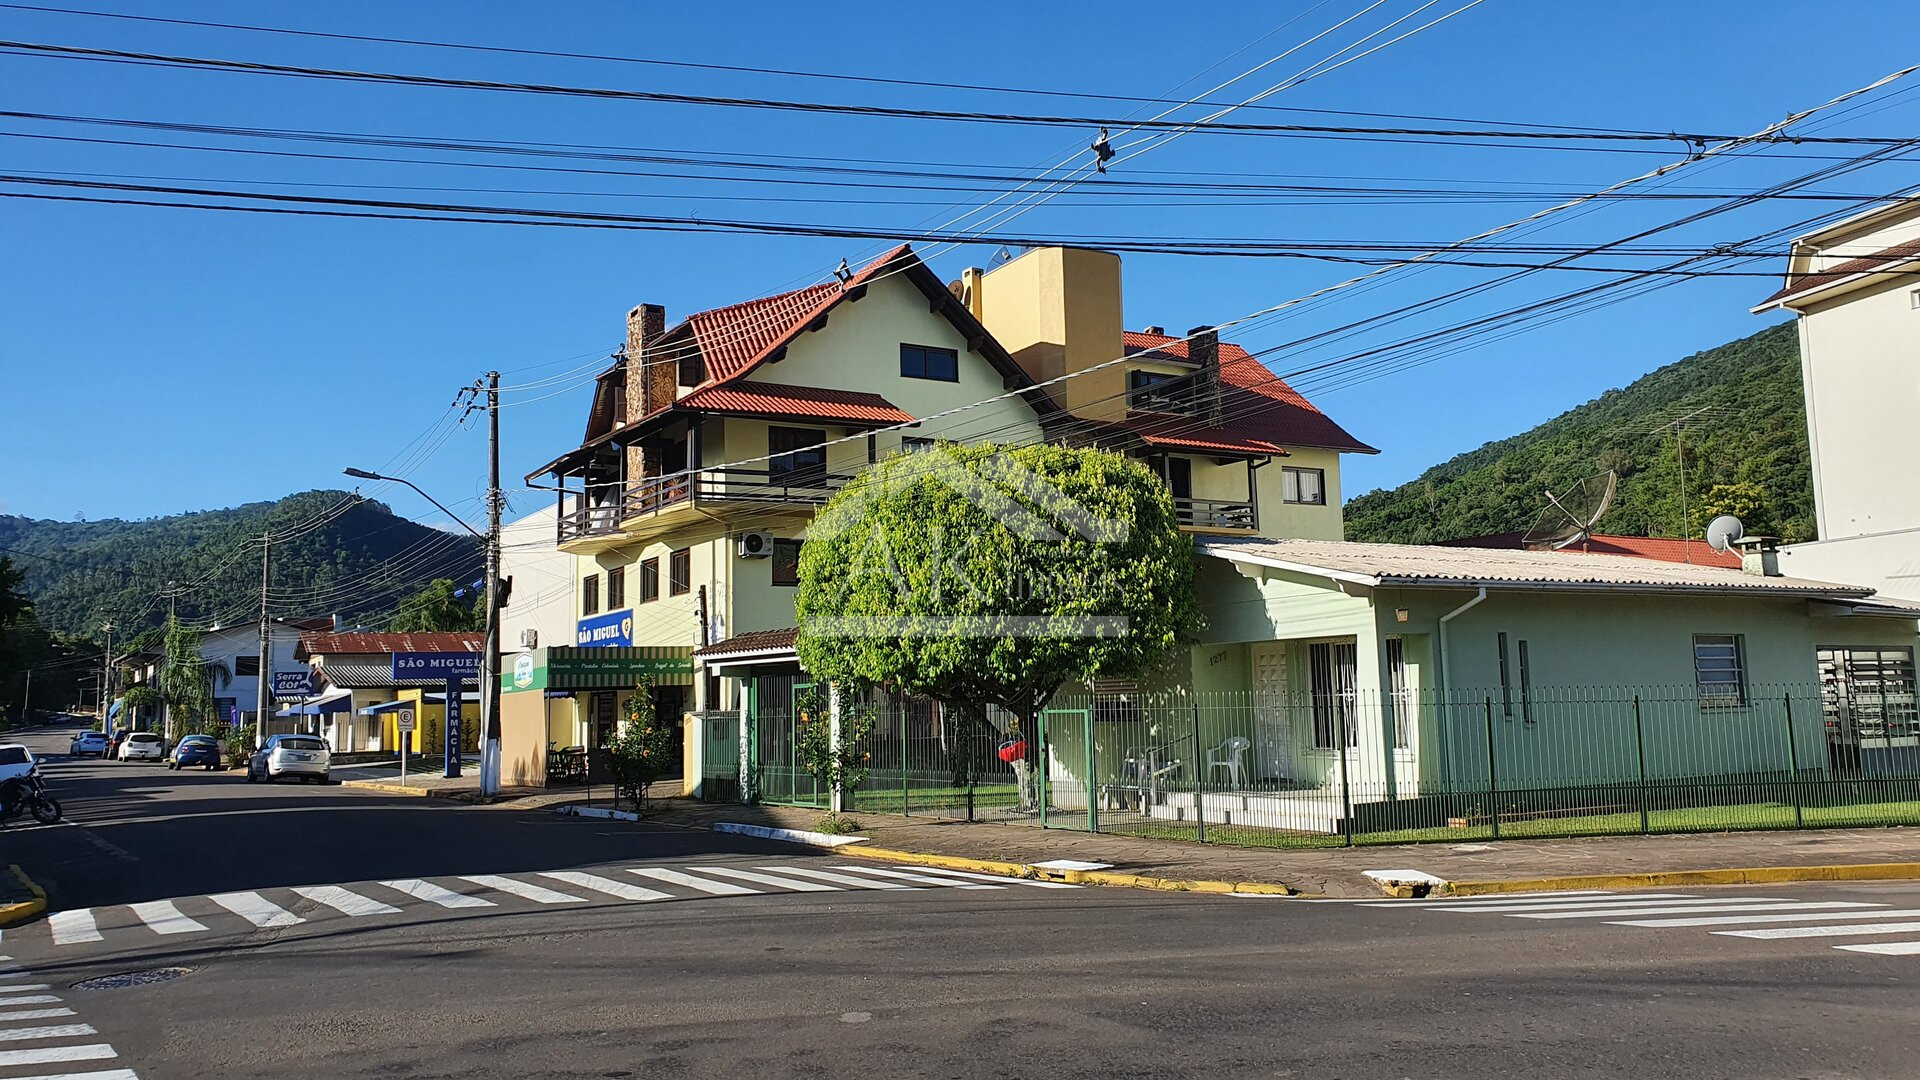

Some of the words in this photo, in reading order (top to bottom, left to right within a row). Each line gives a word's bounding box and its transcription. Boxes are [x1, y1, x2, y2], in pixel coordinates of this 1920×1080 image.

[578, 626, 592, 644] SÃO
[593, 624, 620, 641] MIGUEL
[398, 657, 425, 668] SÃO
[430, 658, 481, 667] MIGUEL
[277, 672, 303, 681] Serra
[450, 691, 459, 764] FARMÁCIA
